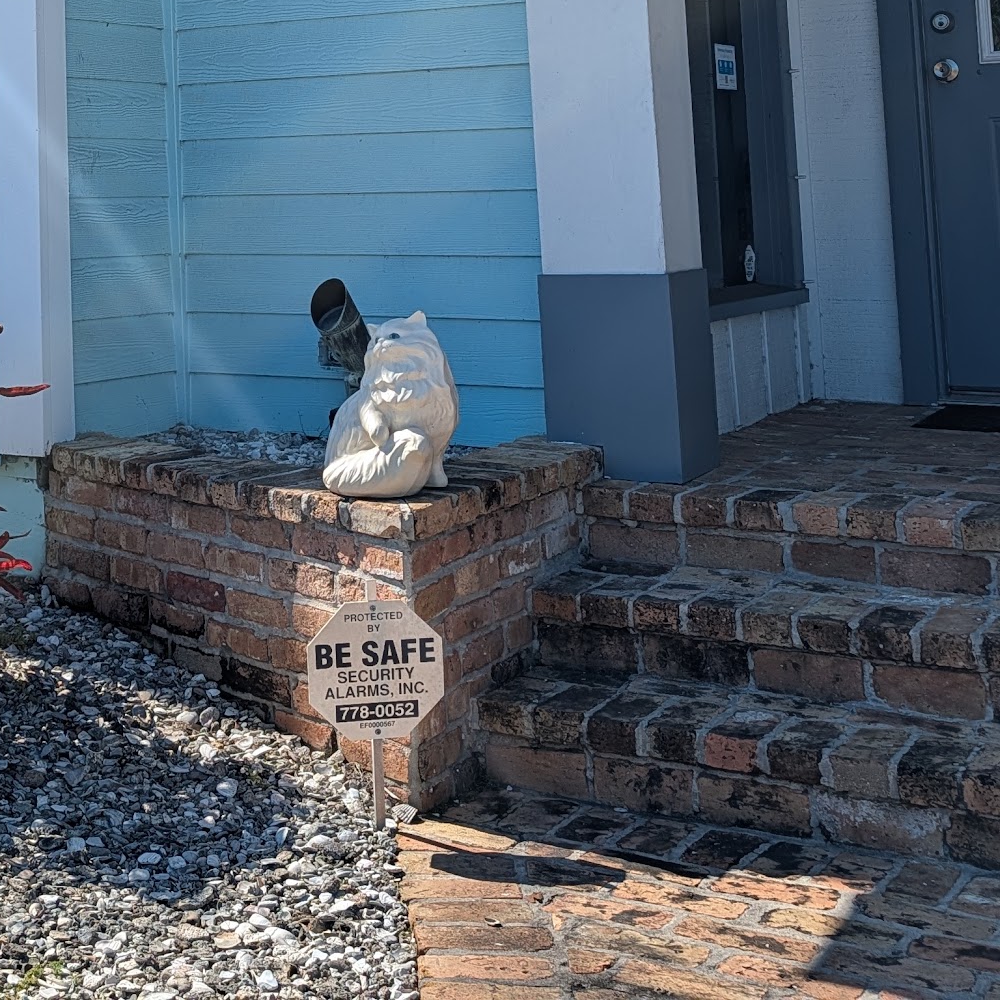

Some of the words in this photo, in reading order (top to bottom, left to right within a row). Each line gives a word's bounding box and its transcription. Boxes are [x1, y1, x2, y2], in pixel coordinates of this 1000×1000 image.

[344, 611, 403, 623] PROTECTED
[367, 624, 381, 633] BY
[315, 643, 352, 669] BE
[361, 637, 436, 667] SAFE
[337, 667, 415, 683] SECURITY
[325, 684, 394, 700] ALARMS,
[398, 681, 428, 695] INC.
[340, 703, 415, 720] 778-0052
[359, 720, 396, 729] EF0000567
